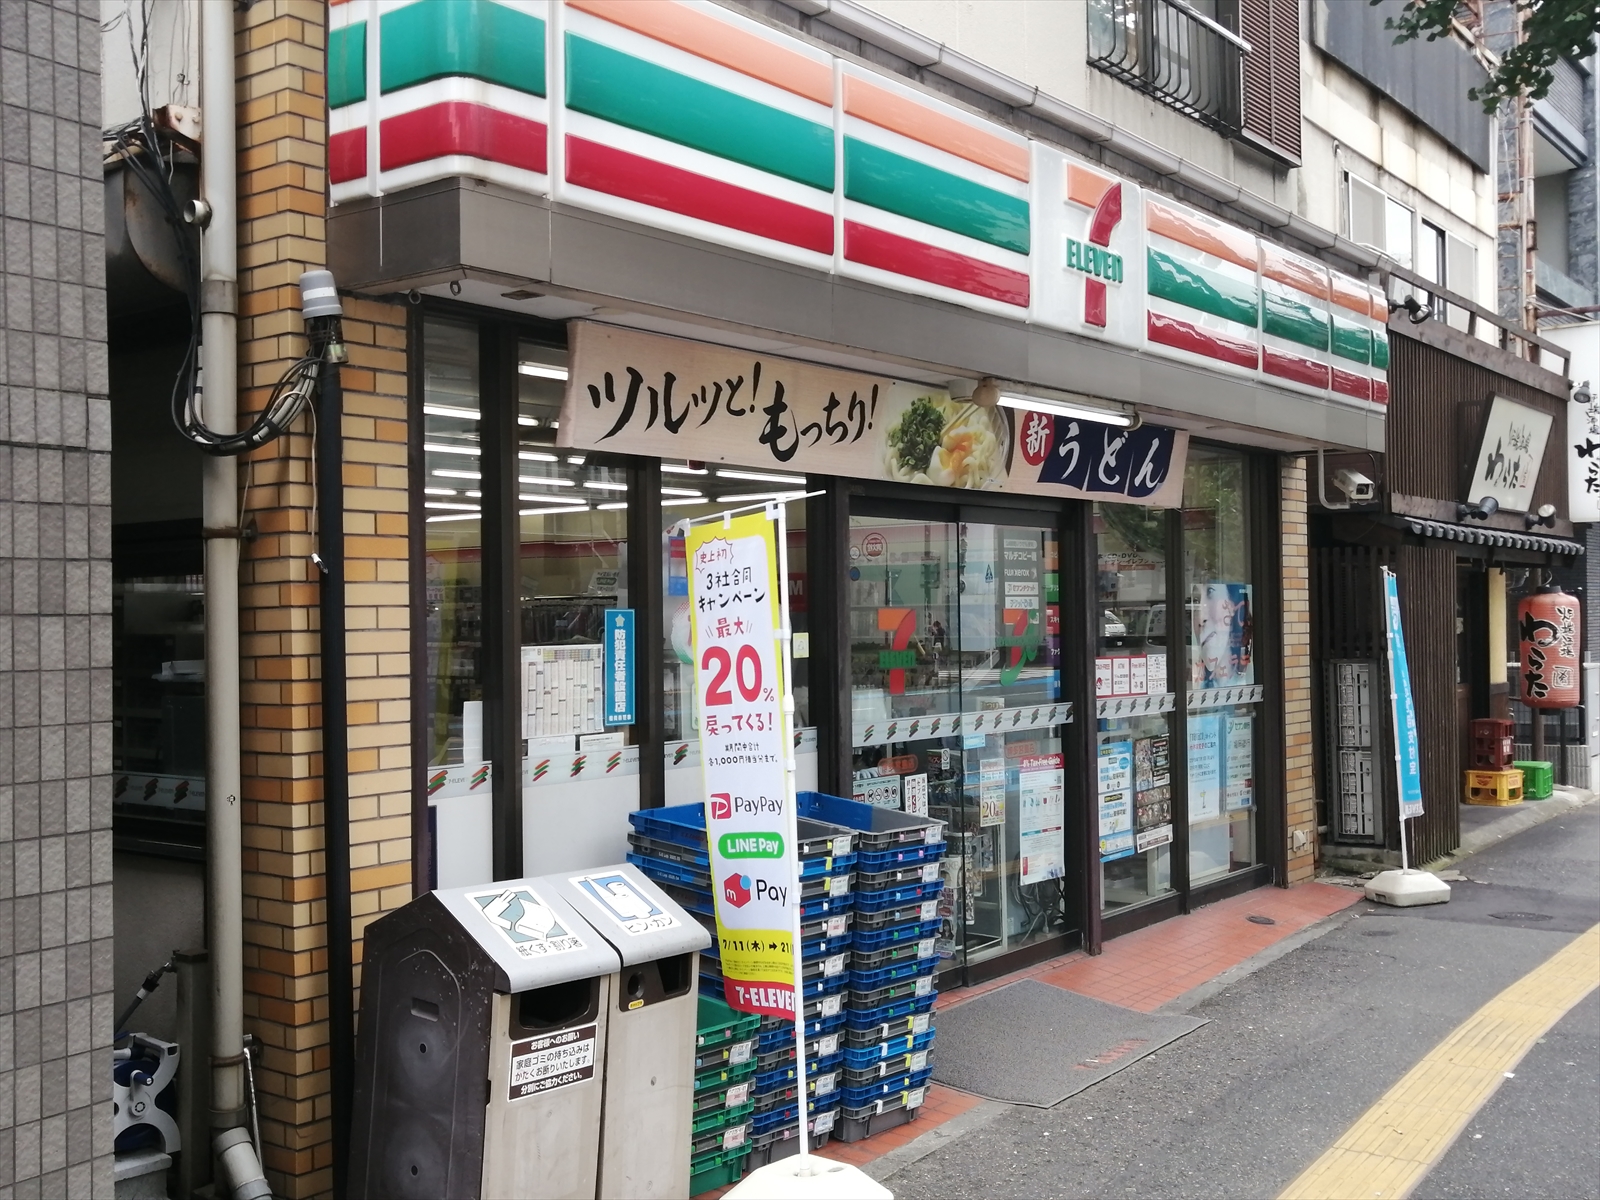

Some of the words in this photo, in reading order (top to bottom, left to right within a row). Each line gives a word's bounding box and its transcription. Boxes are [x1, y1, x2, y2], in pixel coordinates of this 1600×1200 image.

[1067, 163, 1122, 328] 7
[1025, 417, 1049, 457] 新
[1057, 421, 1164, 489] うどん
[699, 548, 728, 565] 史上初
[705, 566, 753, 591] 3社合同
[698, 587, 766, 613] キャンペーン
[715, 615, 745, 639] 最大
[701, 643, 775, 707] 20%
[704, 711, 773, 736] 戻ってくる!
[724, 742, 760, 753] 期間中合計
[734, 796, 783, 816] PayPay
[727, 838, 757, 854] LINE
[758, 839, 779, 855] Pay
[756, 879, 788, 908] Pay
[515, 1043, 591, 1071] 家庭ゴミの持ち込みは
